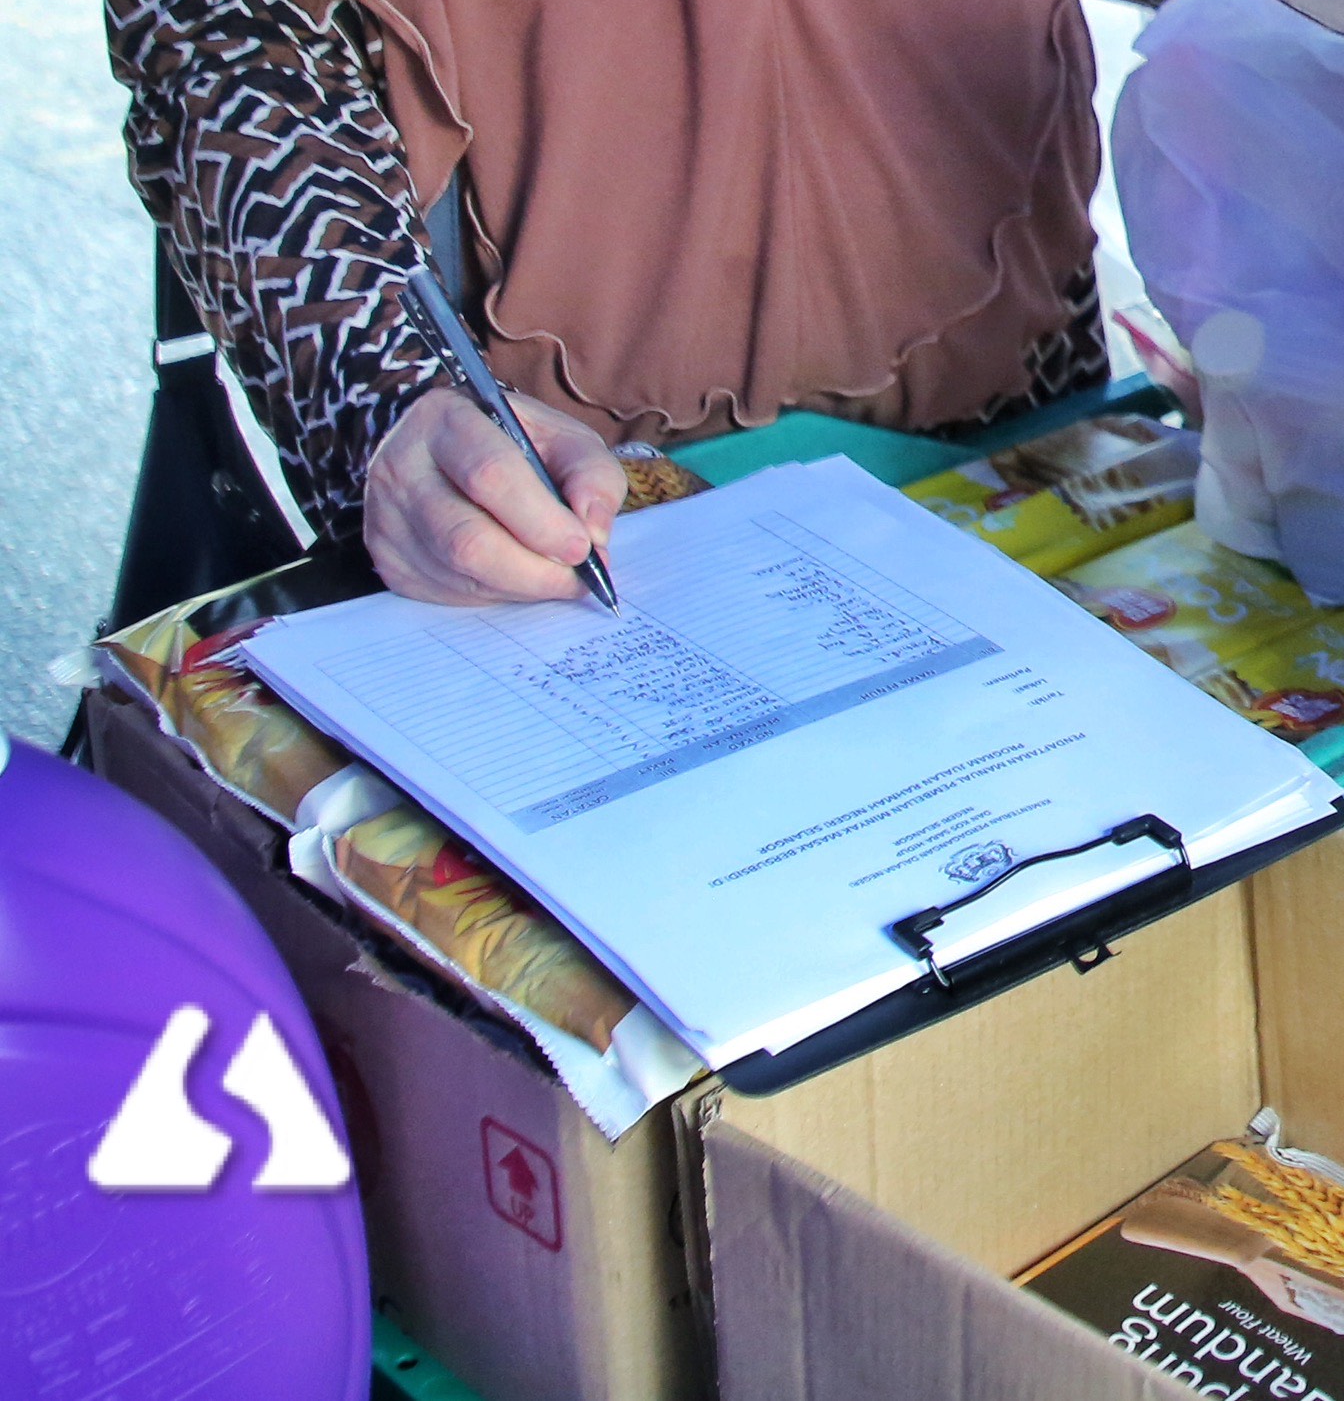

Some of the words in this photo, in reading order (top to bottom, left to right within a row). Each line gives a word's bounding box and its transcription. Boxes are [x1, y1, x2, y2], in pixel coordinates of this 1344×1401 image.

[967, 741, 1025, 770] PROGRAM
[1008, 731, 1086, 768] PENDAFTARAN
[922, 764, 966, 788] JUALAN
[957, 762, 1007, 788] MANUAL
[867, 783, 921, 810] RAHMAH
[891, 782, 958, 815] PEMBELIAN
[823, 805, 867, 828] NEGERI
[842, 809, 891, 835] MINYAK
[757, 823, 823, 855] SELANGOR
[797, 829, 842, 853] MASAK
[1217, 1299, 1264, 1332] Flour
[1255, 1324, 1315, 1367] Wheat
